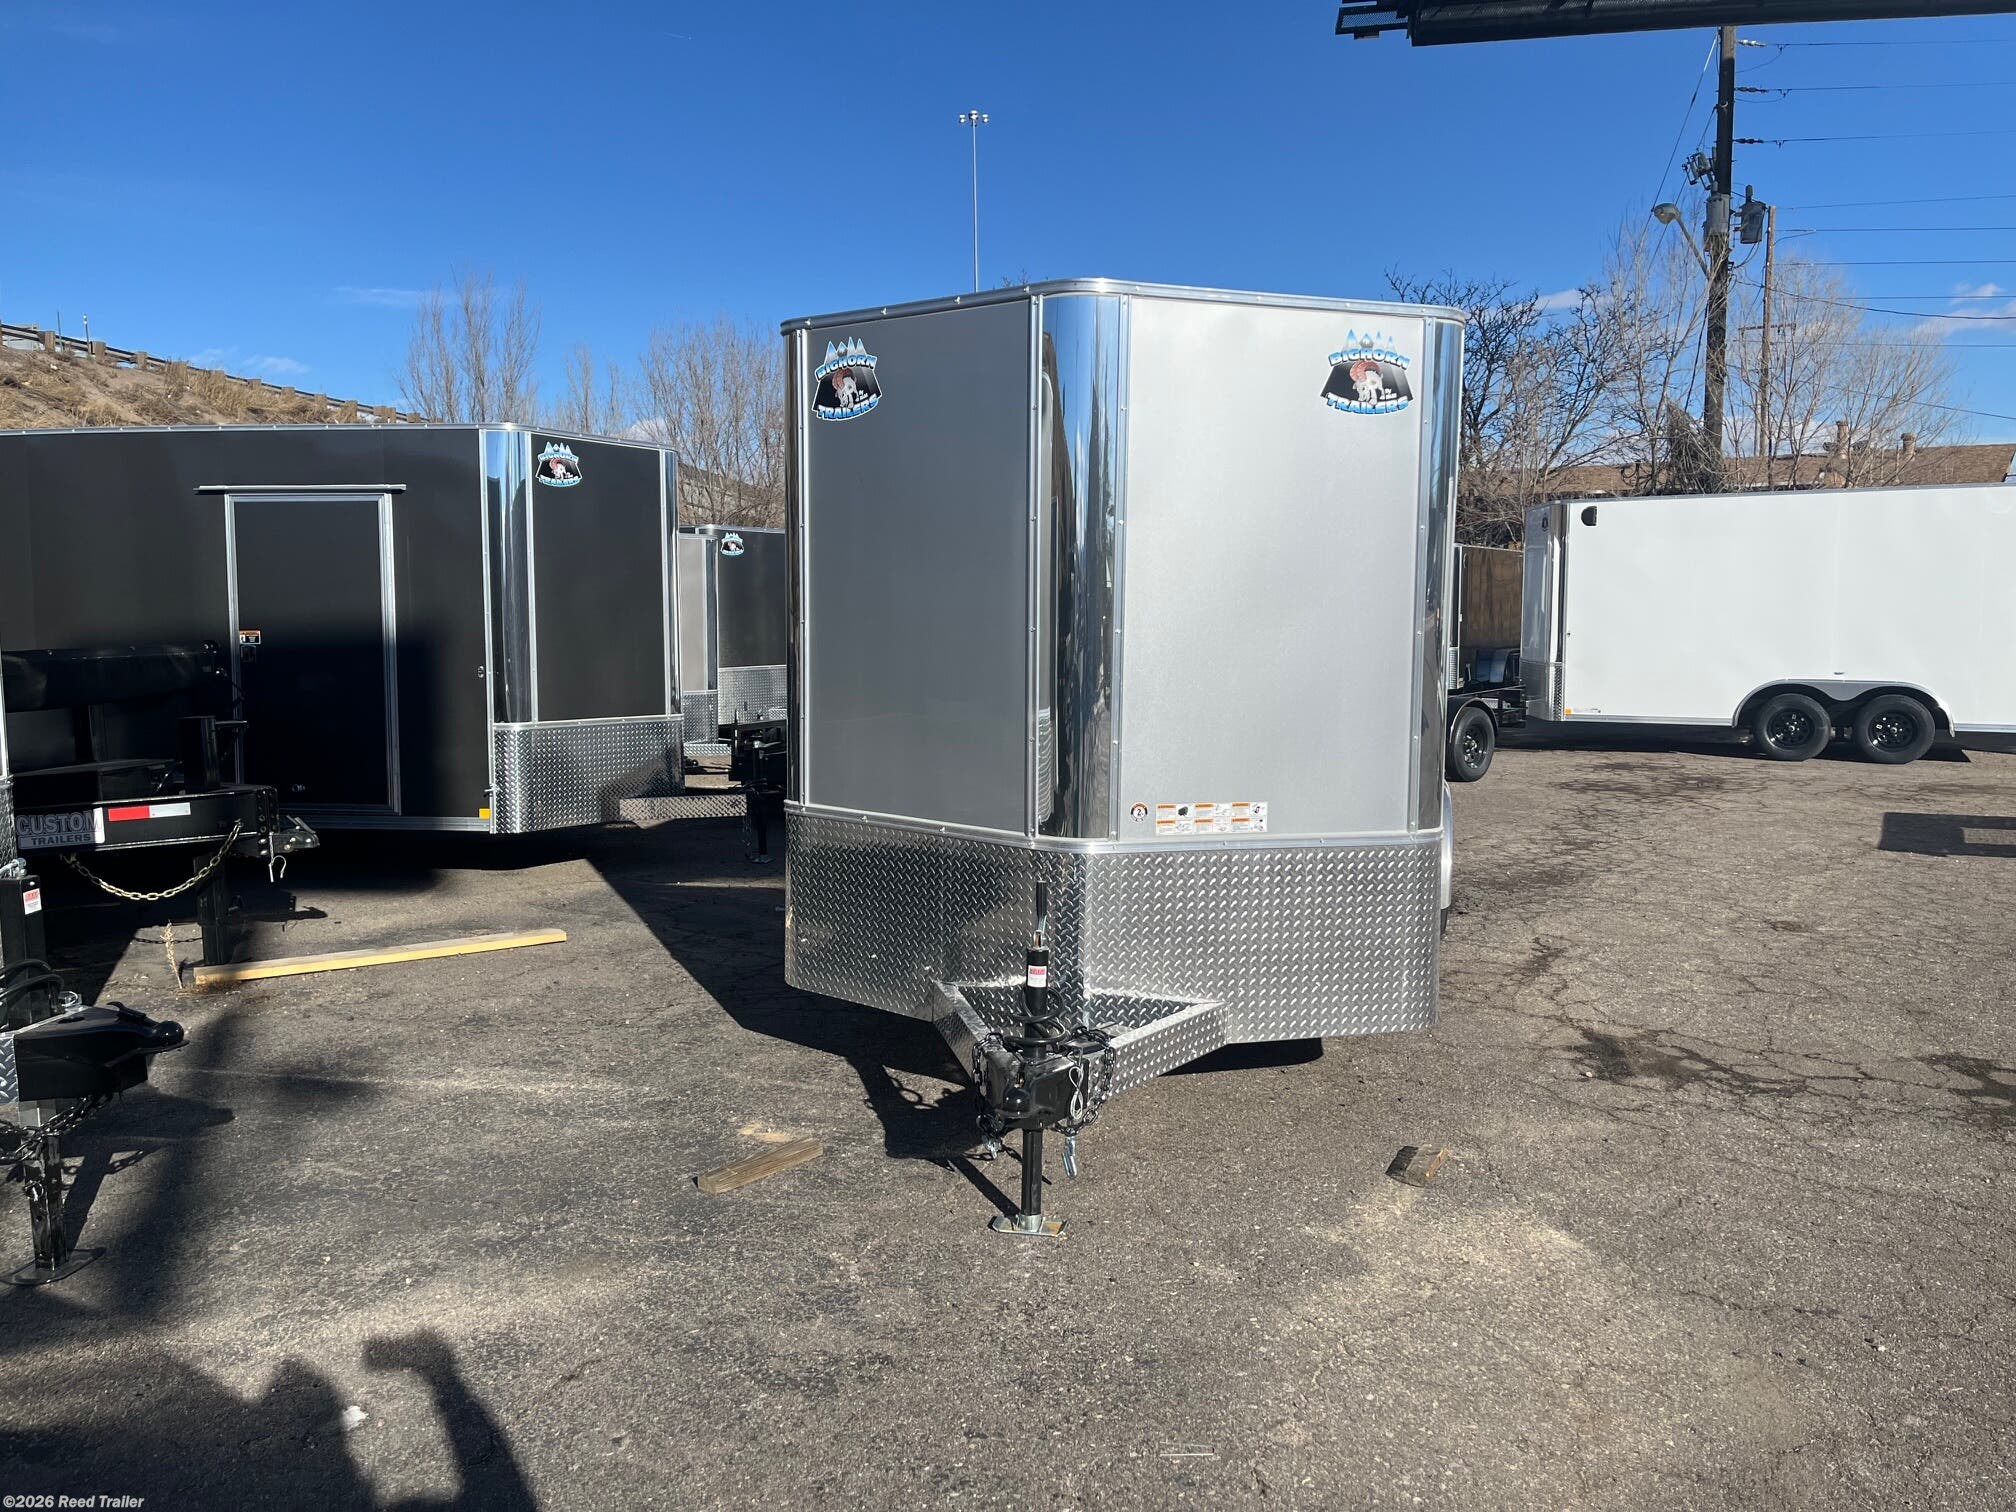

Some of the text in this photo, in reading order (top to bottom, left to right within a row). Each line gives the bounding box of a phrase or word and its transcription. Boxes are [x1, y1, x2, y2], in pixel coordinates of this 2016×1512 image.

[816, 354, 877, 380] BIGHORN
[1328, 347, 1411, 370] BIGHORN
[817, 395, 879, 420] TRAILERS
[1326, 392, 1410, 415] TRAILERS
[15, 810, 104, 836] CUSTOM
[31, 833, 91, 846] TRAILERS
